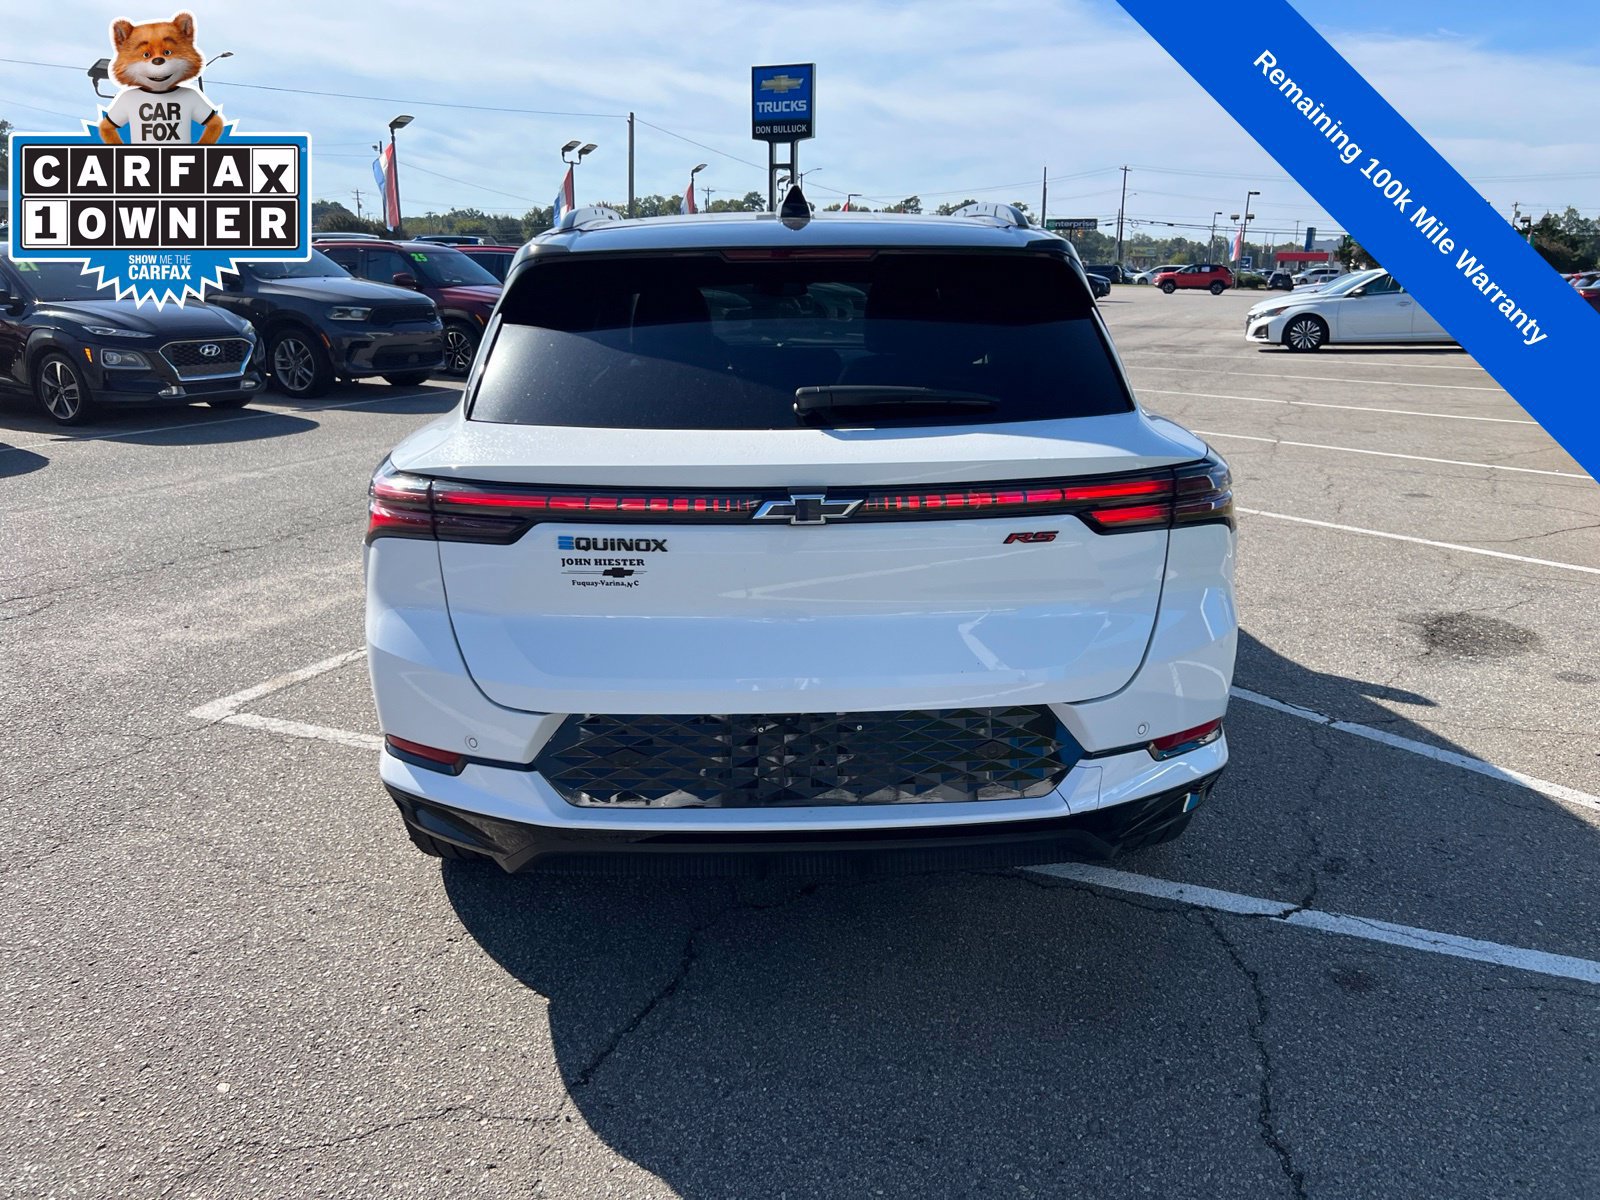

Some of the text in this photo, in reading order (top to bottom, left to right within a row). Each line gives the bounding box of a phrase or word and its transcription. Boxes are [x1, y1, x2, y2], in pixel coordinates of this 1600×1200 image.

[757, 100, 807, 113] TRUCKS
[756, 124, 807, 134] DON BULLUCK
[558, 536, 668, 552] EQUINOX
[1003, 531, 1059, 544] RS
[561, 558, 645, 567] JOHN HIESTER
